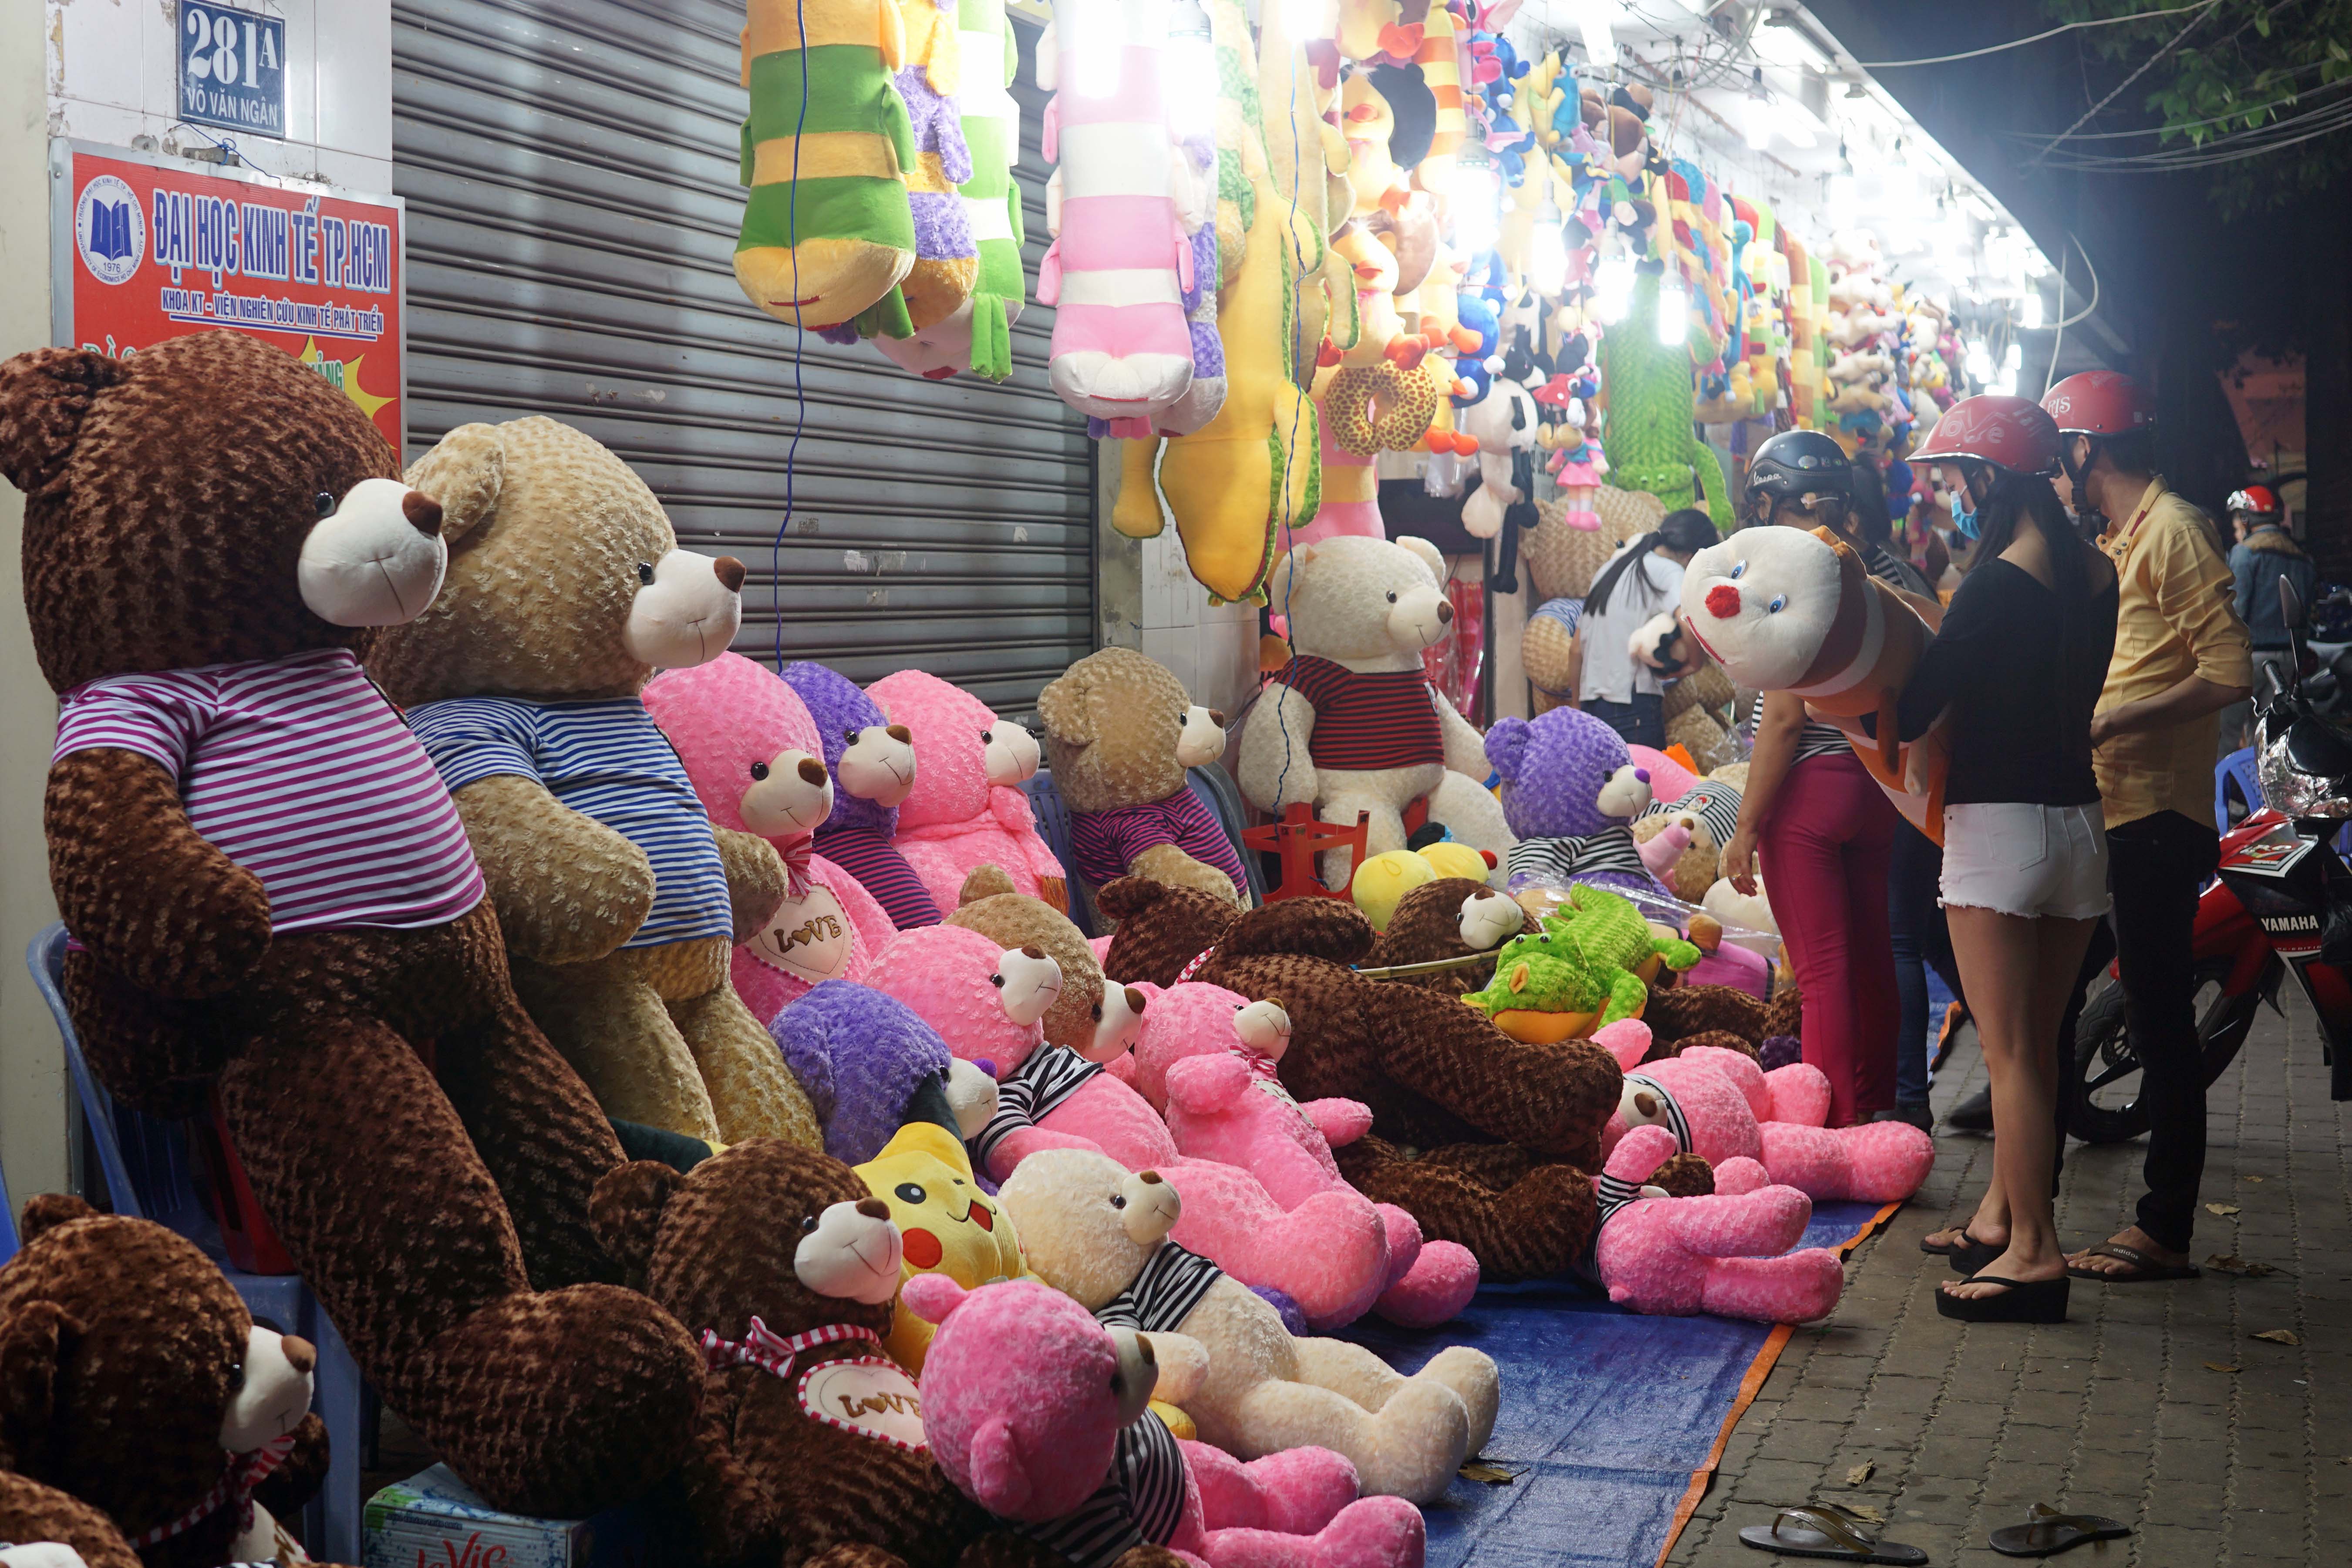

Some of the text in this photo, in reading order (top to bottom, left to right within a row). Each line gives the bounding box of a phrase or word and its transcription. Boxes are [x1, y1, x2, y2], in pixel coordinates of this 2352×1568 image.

[187, 8, 279, 89] 281A
[187, 84, 277, 127] VÕ VĂN NGÂN
[154, 190, 389, 289] ĐẠI HỌC KINH TẾ TP.HCM
[103, 262, 121, 273] 1976
[162, 289, 189, 312] KHOA
[192, 293, 203, 313] KT
[214, 293, 237, 319] VIỆN
[240, 296, 273, 320] NGHIÊN
[276, 299, 294, 323] CỨU
[297, 306, 317, 326] KINH
[320, 303, 331, 327] TẾ
[334, 306, 356, 329] PHÁT
[358, 306, 383, 332] TRIỂN
[1753, 471, 1782, 487] Vespa
[2261, 915, 2319, 931] YAMAHA
[2113, 1248, 2139, 1260] adidas
